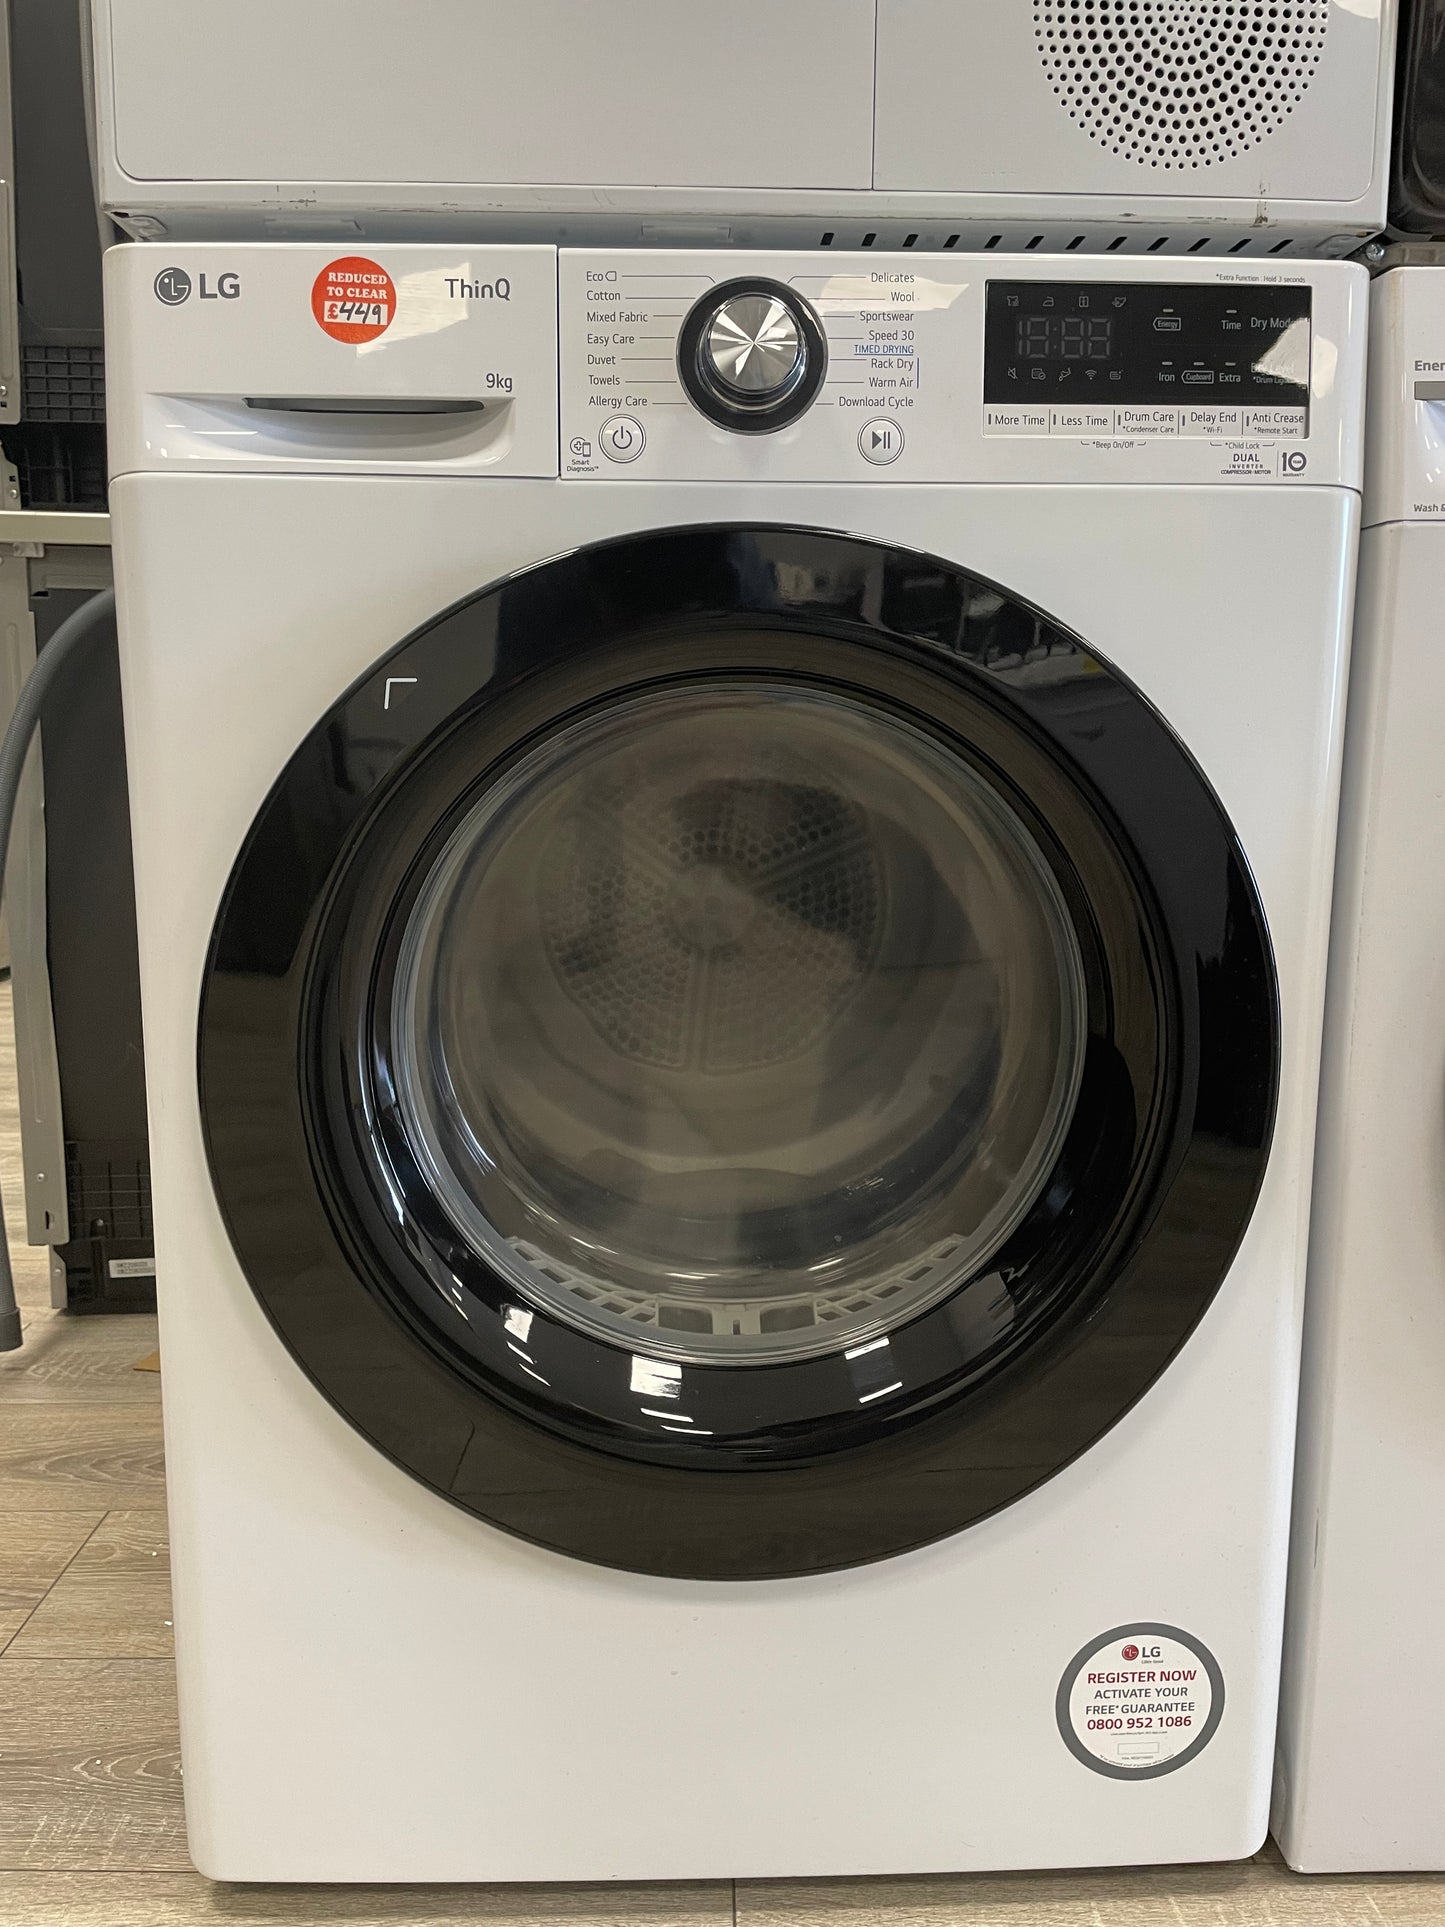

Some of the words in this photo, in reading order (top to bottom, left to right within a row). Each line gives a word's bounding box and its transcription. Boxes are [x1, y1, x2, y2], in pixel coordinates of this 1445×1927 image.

[328, 271, 388, 285] REDUCED
[586, 271, 604, 281] Eco
[871, 272, 915, 283] Delicates
[1235, 274, 1259, 282] Function
[199, 272, 240, 299] LG
[444, 278, 511, 301] ThinQ
[327, 286, 344, 297] TO
[345, 287, 388, 299] CLEAR
[586, 290, 621, 301] Cotton
[891, 291, 915, 302] Wool
[586, 312, 616, 322] Mixed
[619, 312, 648, 322] Fabric
[859, 311, 914, 323] Sportswear
[1157, 320, 1178, 329] Energy
[1221, 320, 1242, 330] Time
[1250, 317, 1267, 330] Dry
[1270, 317, 1294, 329] Mod
[587, 334, 609, 347] Easy
[612, 334, 635, 344] Care
[869, 330, 898, 342] Speed
[901, 330, 915, 341] 30
[854, 345, 880, 354] TIMED
[882, 345, 914, 354] DRYING
[587, 354, 616, 365] Duvet
[871, 358, 894, 369] Rack
[897, 358, 914, 371] Dry
[486, 372, 513, 393] 9kg
[588, 375, 621, 385] Towels
[869, 377, 896, 388] Warm
[900, 377, 914, 388] Air
[1158, 372, 1175, 382] Iron
[1219, 372, 1241, 382] Extra
[588, 396, 622, 409] Allergy
[625, 396, 648, 406] Care
[839, 396, 886, 407] Download
[888, 396, 914, 409] Cycle
[994, 414, 1019, 426] More
[1022, 414, 1045, 426] Time
[1061, 415, 1082, 426] Less
[1085, 415, 1108, 426] Time
[1124, 411, 1150, 422] Drum
[1152, 411, 1175, 422] Care
[1190, 411, 1216, 425] Delay
[1219, 412, 1237, 423] End
[1252, 412, 1271, 423] Anti
[1273, 412, 1304, 423] Crease
[1282, 426, 1298, 434] Start
[1112, 441, 1134, 449] On/Off
[1233, 453, 1260, 462] DUAL
[1282, 451, 1307, 472] 10
[1413, 503, 1439, 512] Wash
[1142, 1646, 1161, 1658] LG
[1087, 1671, 1156, 1684] REGISTER
[1159, 1670, 1197, 1682] NOW
[1094, 1688, 1151, 1699] ACTIVATE
[1154, 1687, 1188, 1697] YOUR
[1121, 1702, 1195, 1714] GUARANTEE
[1087, 1718, 1123, 1730] 0800
[1126, 1717, 1153, 1729] 952
[1158, 1716, 1192, 1728] 1086
